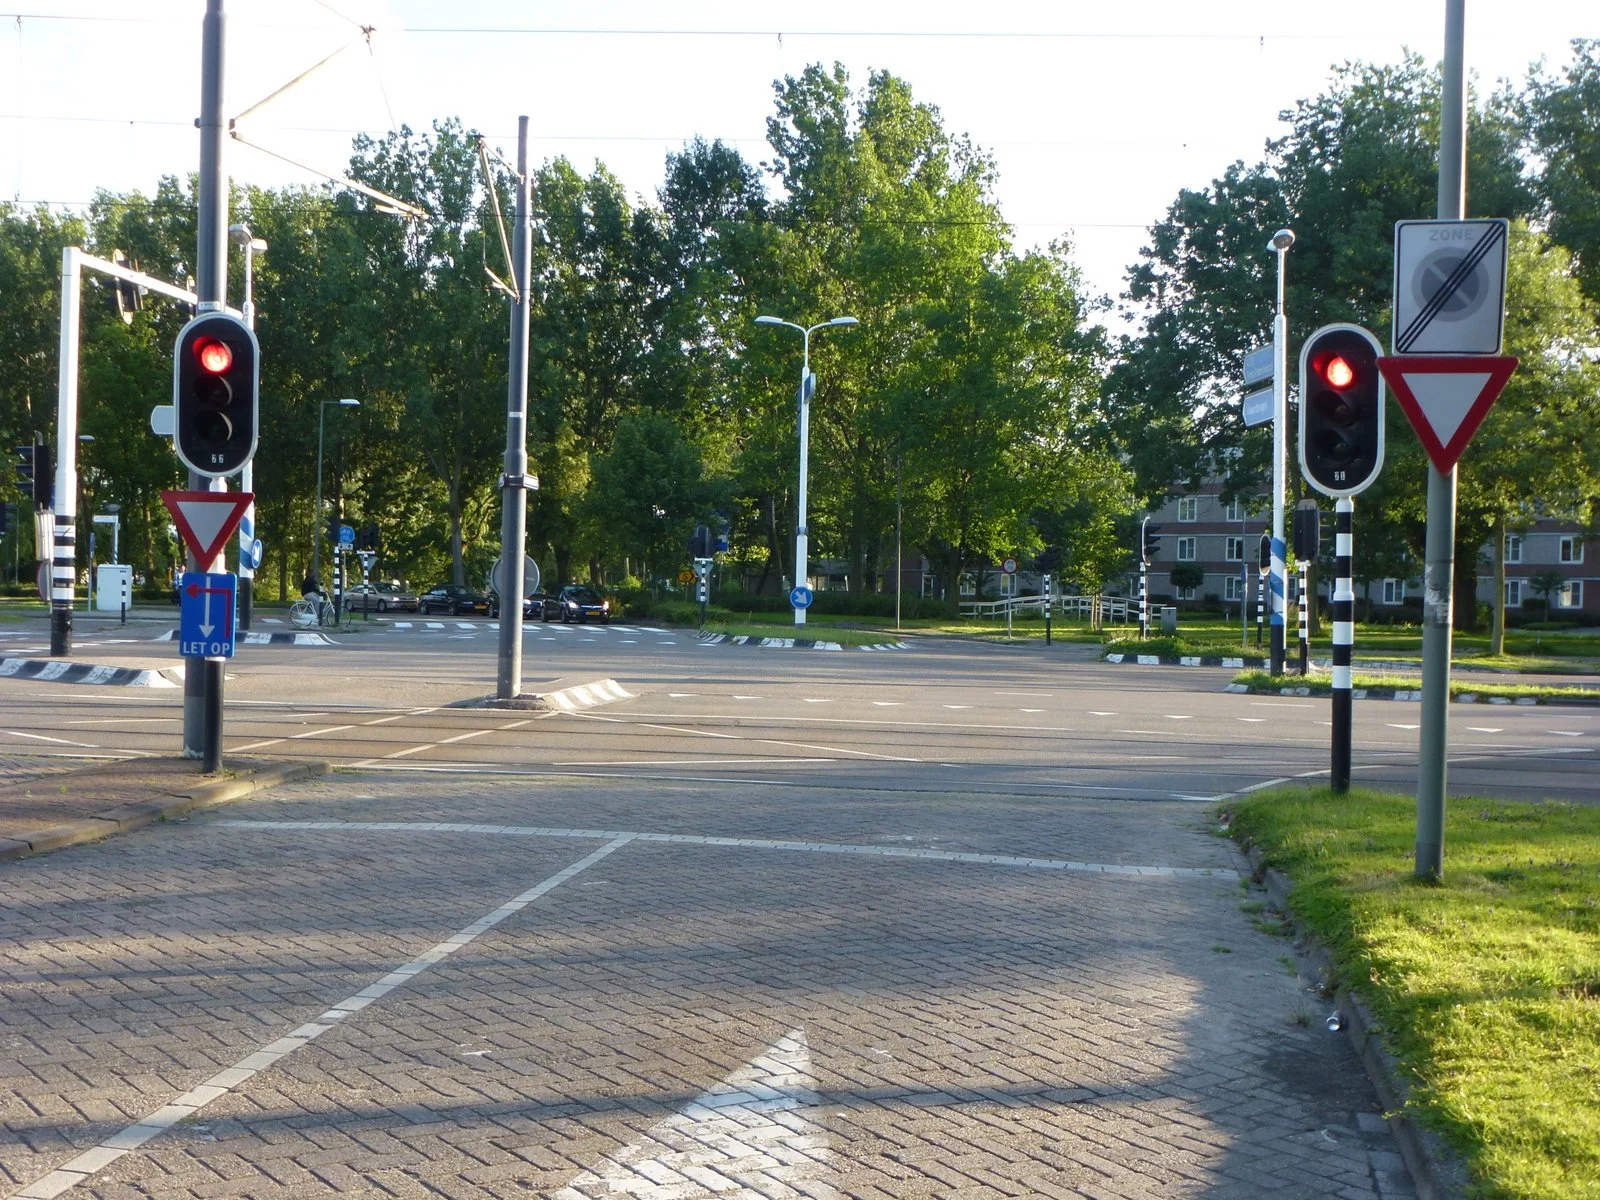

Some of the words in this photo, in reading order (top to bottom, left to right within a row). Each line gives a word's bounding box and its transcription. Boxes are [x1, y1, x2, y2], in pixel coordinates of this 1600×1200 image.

[1429, 229, 1474, 241] ZONE
[183, 641, 207, 654] LET
[211, 642, 230, 655] OP
